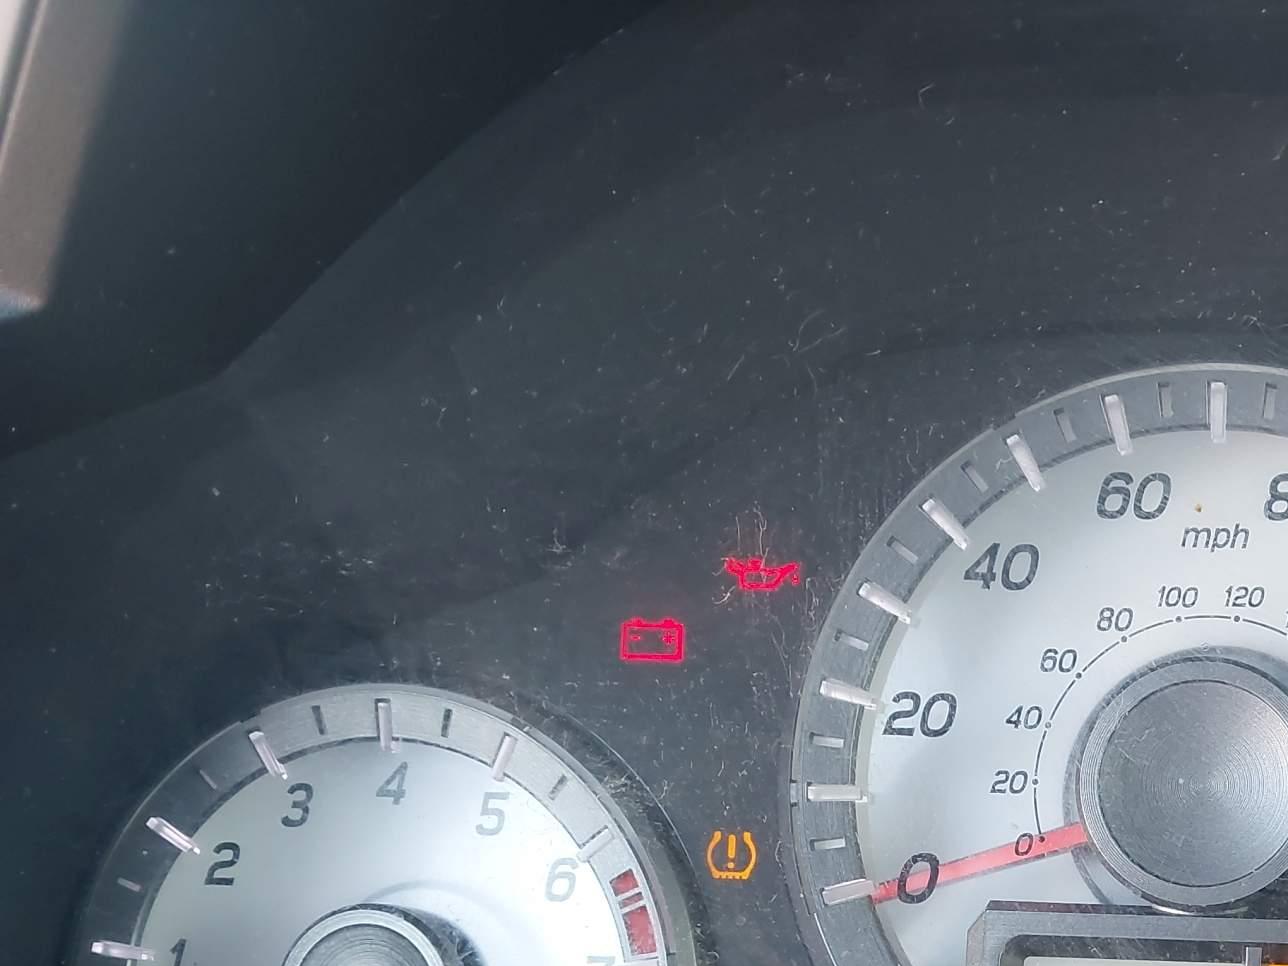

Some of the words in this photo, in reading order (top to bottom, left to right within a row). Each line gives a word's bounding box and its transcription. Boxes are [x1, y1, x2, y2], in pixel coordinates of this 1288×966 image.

[1096, 472, 1172, 520] 60
[1181, 523, 1250, 552] mph
[963, 543, 1040, 591] 40
[1157, 586, 1199, 608] 100
[1224, 586, 1265, 608] 120
[1096, 607, 1134, 632] 80
[1040, 649, 1078, 673] 60
[882, 691, 957, 738] 20
[1005, 705, 1043, 730] 40
[376, 761, 408, 806] 4
[989, 770, 1029, 794] 20
[280, 783, 315, 828] 3
[475, 792, 511, 836] 5
[204, 841, 241, 886] 2
[1014, 832, 1034, 857] 0
[544, 857, 578, 903] 6
[897, 852, 939, 904] 0
